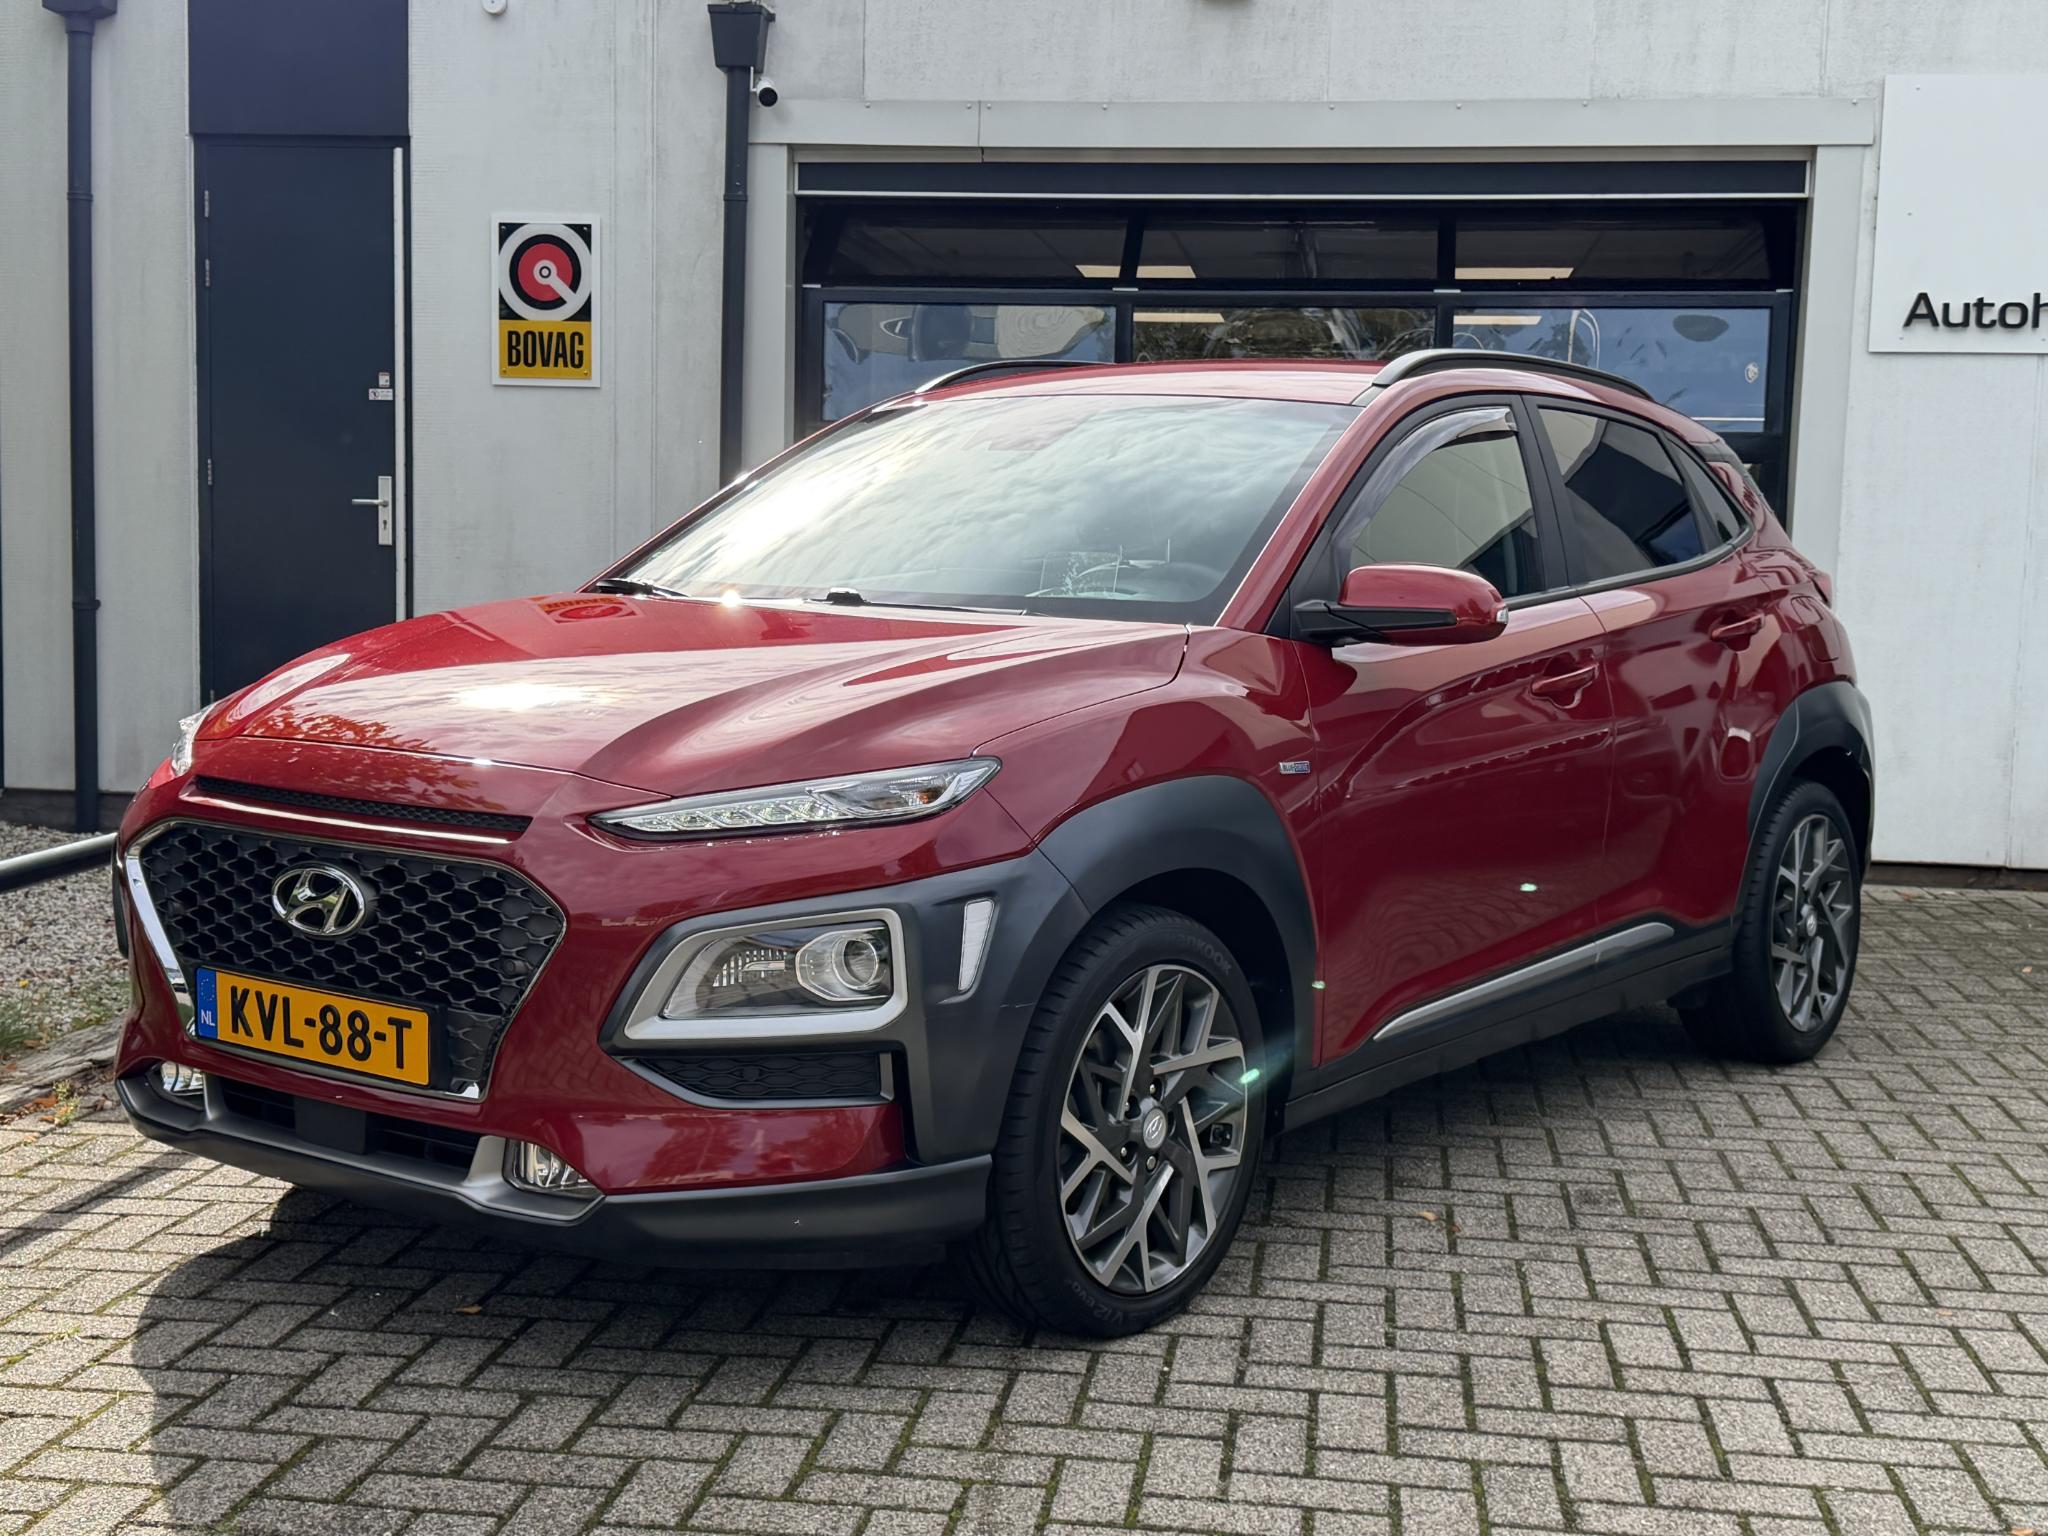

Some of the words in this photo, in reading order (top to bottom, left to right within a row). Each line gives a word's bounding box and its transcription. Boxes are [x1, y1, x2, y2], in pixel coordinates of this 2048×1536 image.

[507, 330, 584, 369] BOVAG
[200, 1009, 216, 1027] NL
[230, 985, 412, 1070] KVL-88-T
